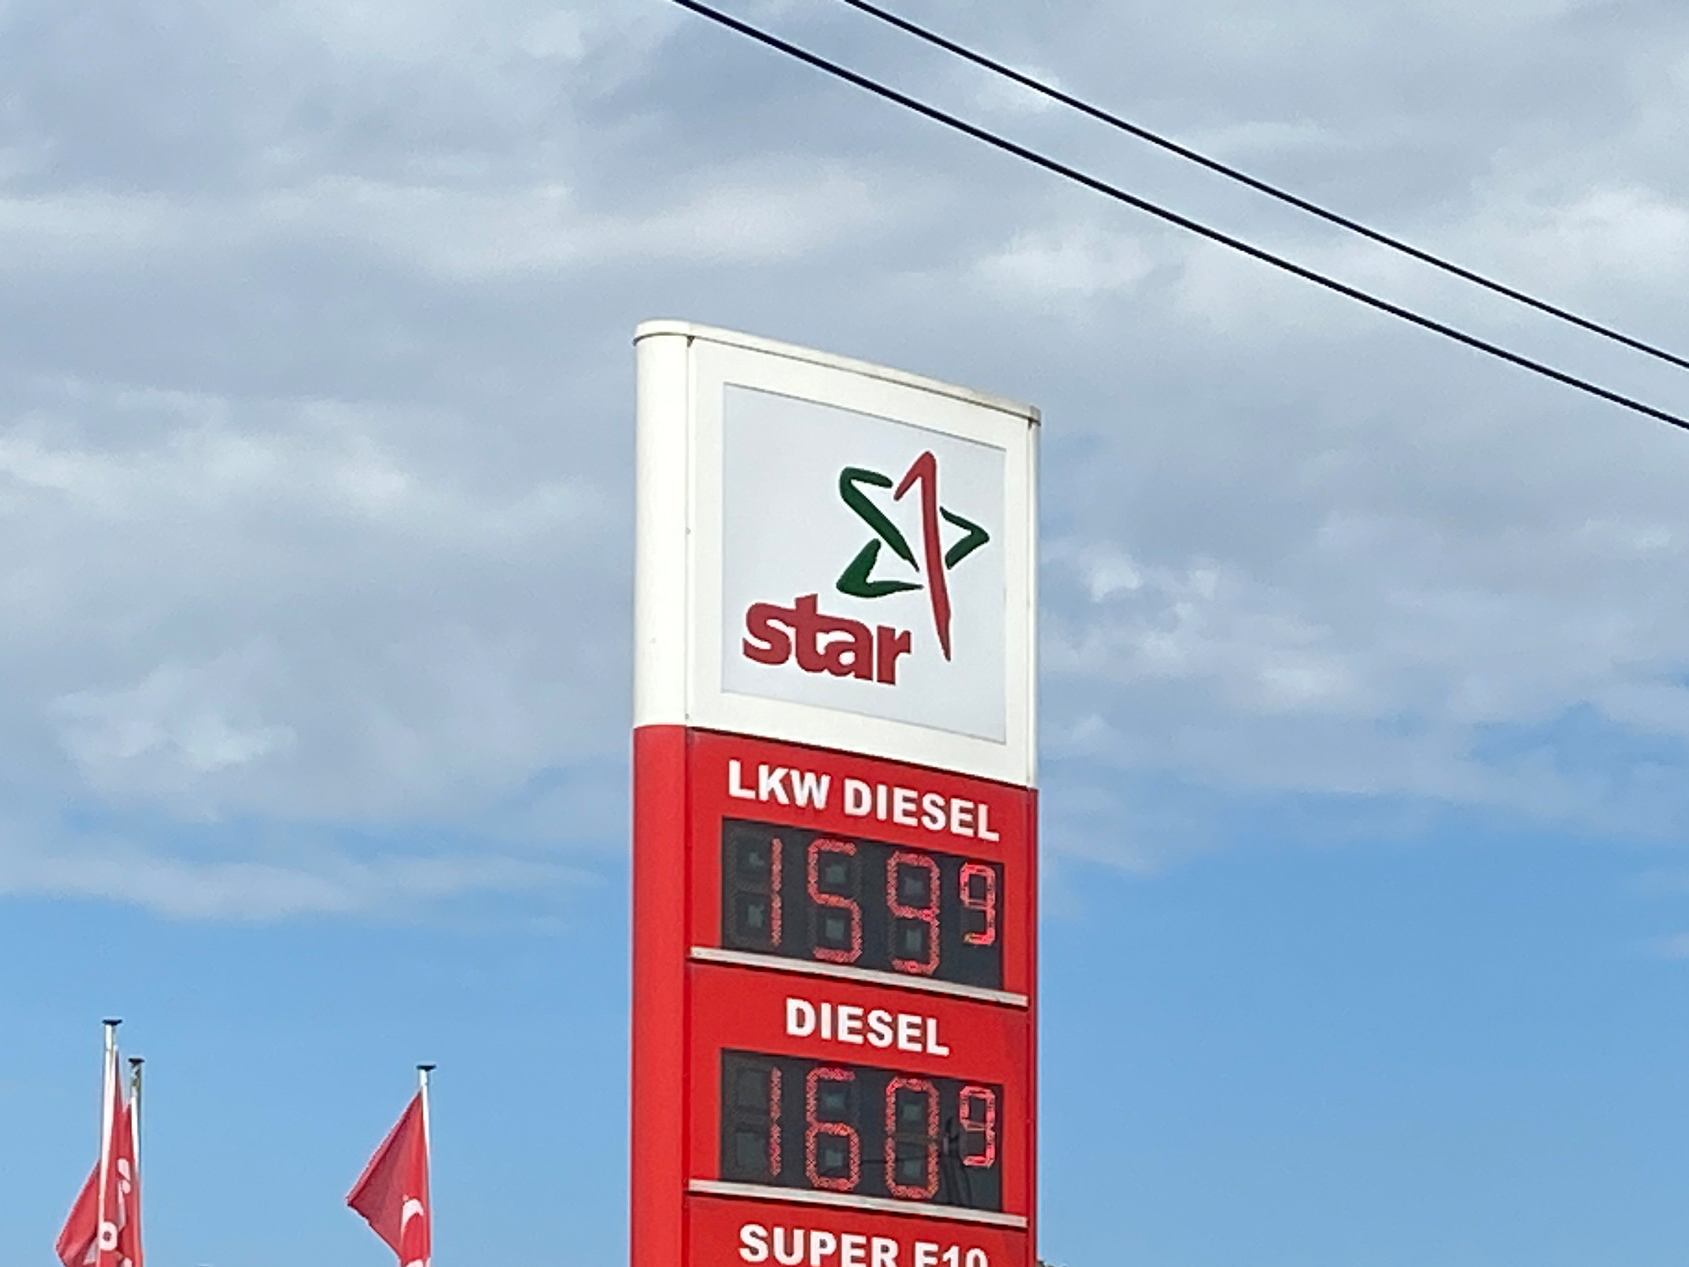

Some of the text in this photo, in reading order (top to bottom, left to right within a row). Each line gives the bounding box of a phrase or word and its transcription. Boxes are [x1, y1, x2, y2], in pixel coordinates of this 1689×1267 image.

[743, 593, 911, 686] star
[729, 759, 999, 842] LKW DIESEL
[786, 998, 949, 1056] DIESEL
